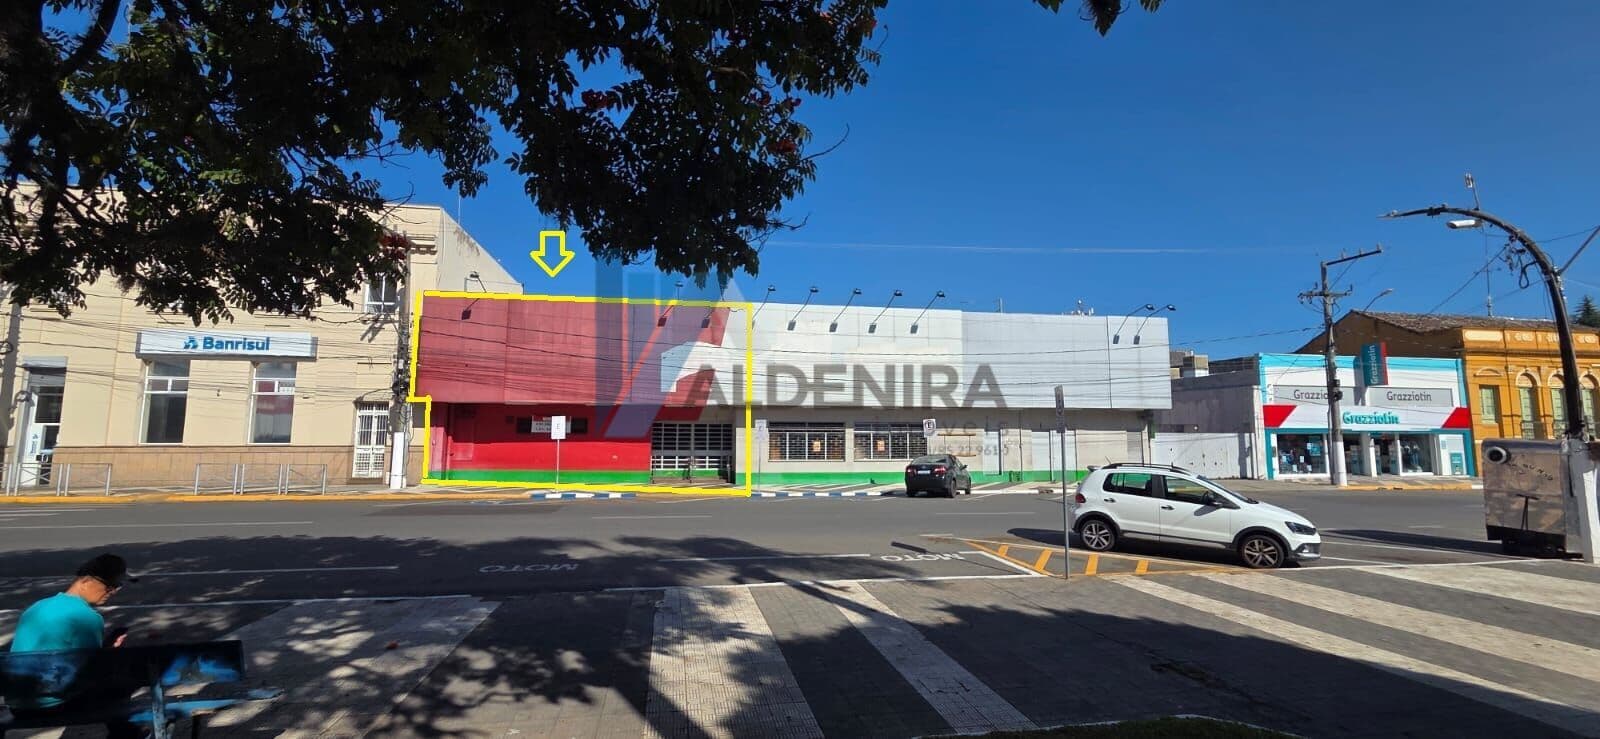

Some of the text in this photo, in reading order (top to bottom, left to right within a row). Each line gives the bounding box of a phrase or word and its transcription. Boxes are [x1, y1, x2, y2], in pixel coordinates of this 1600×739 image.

[202, 336, 270, 351] Banrisul
[1368, 344, 1378, 385] Grazziotin
[1293, 389, 1329, 400] Grazzio
[1386, 391, 1432, 402] Grazziotin
[1342, 412, 1400, 425] Grazziotin
[880, 553, 965, 562] MOTO
[479, 563, 580, 573] MOTO
